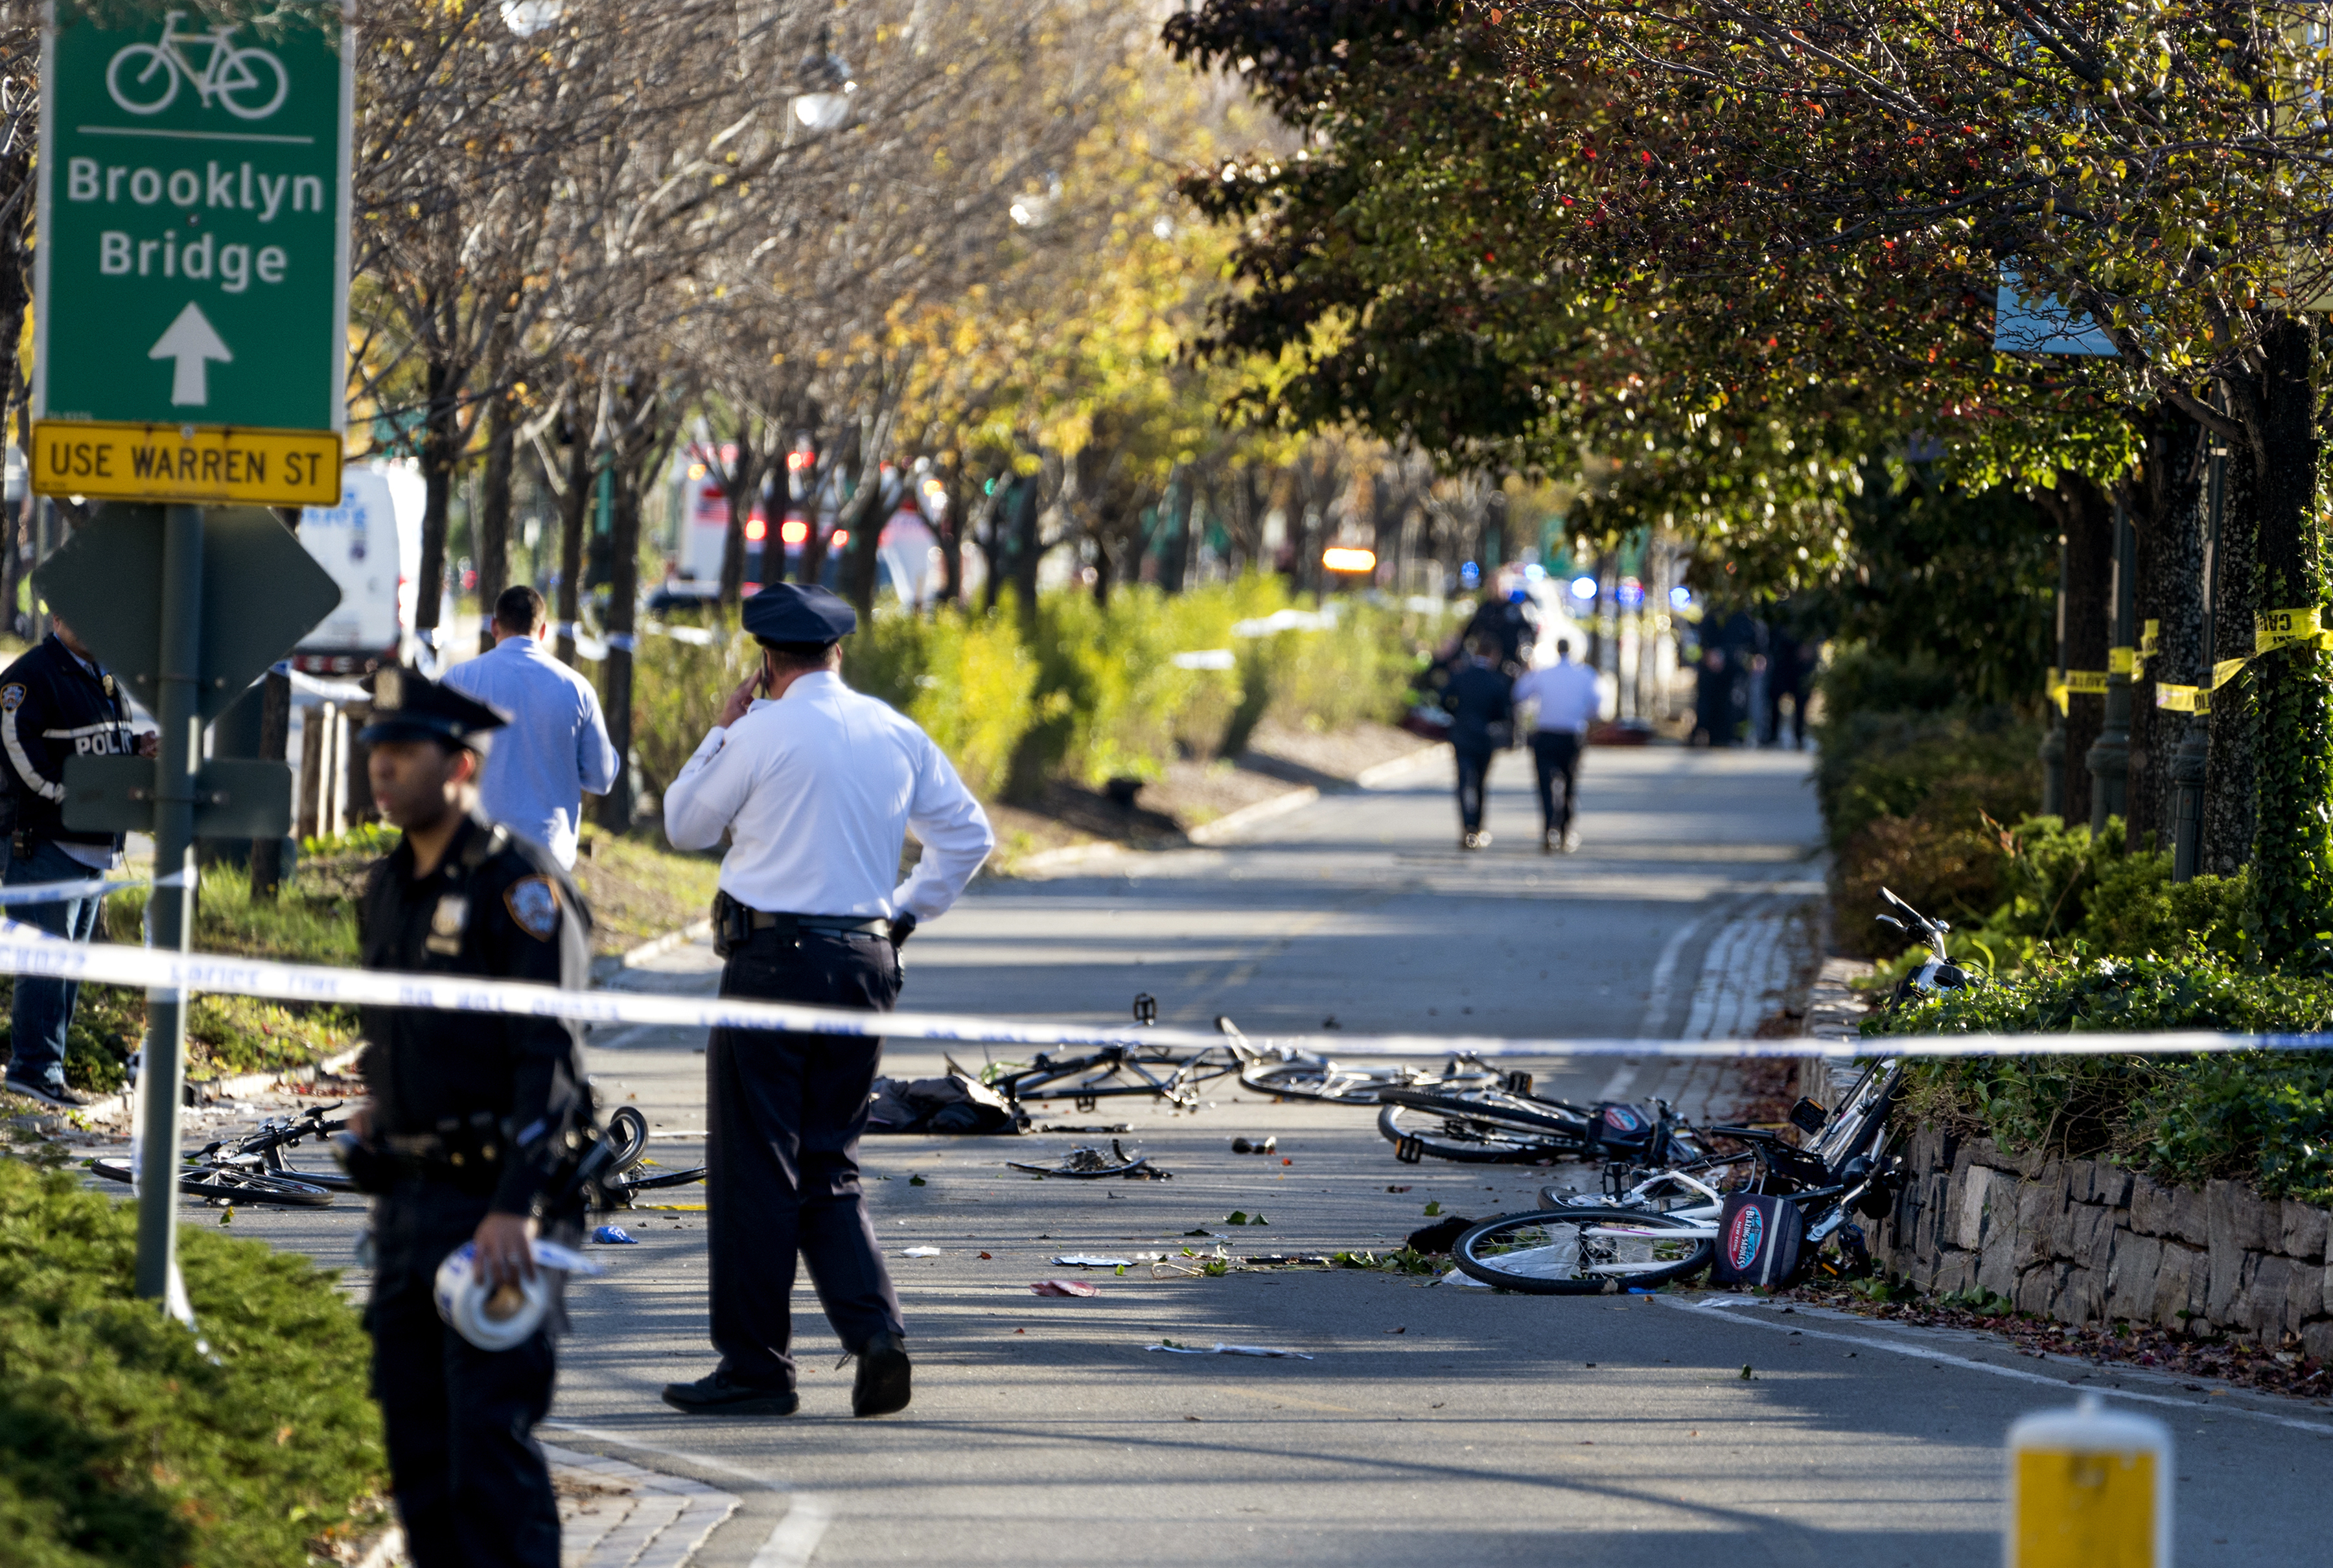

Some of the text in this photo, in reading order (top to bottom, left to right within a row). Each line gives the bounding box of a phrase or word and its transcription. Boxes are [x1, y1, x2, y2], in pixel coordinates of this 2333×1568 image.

[67, 156, 323, 223] Brooklyn
[99, 229, 288, 294] Bridge
[50, 442, 323, 487] USE WARREN ST
